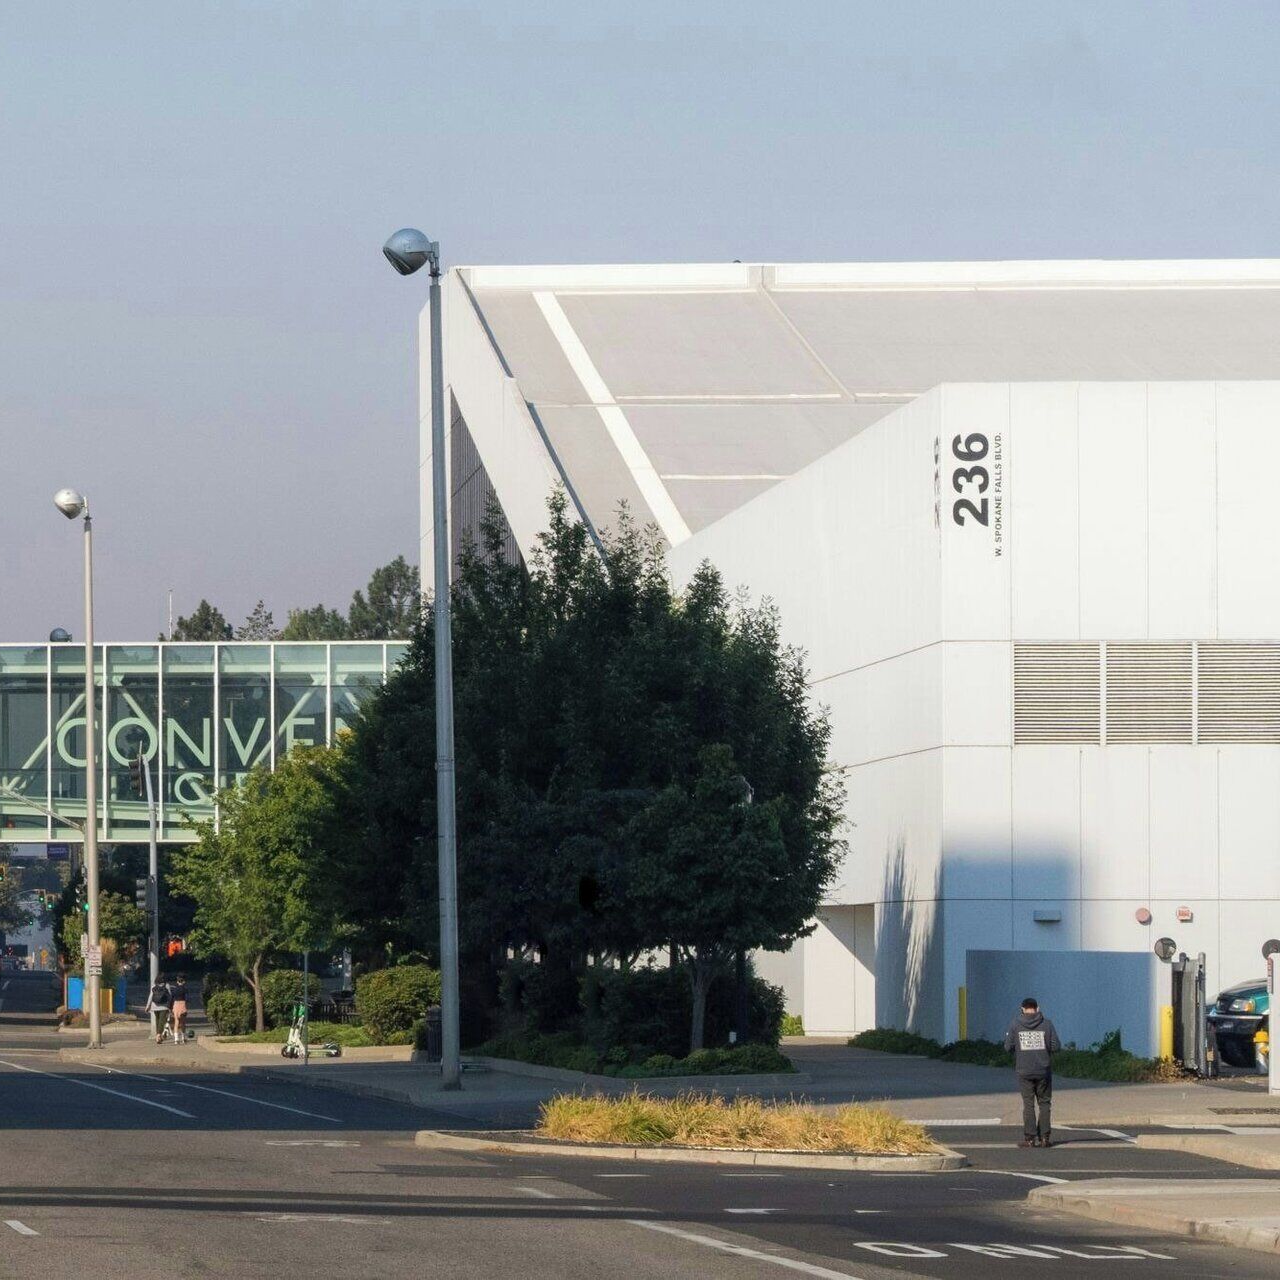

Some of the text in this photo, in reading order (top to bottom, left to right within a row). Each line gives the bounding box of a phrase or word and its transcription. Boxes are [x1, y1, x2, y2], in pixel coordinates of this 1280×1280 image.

[952, 432, 989, 527] 236
[994, 463, 1002, 493] FALLS
[994, 495, 1002, 542] SPOKANE
[852, 1242, 1178, 1259] ONLY
